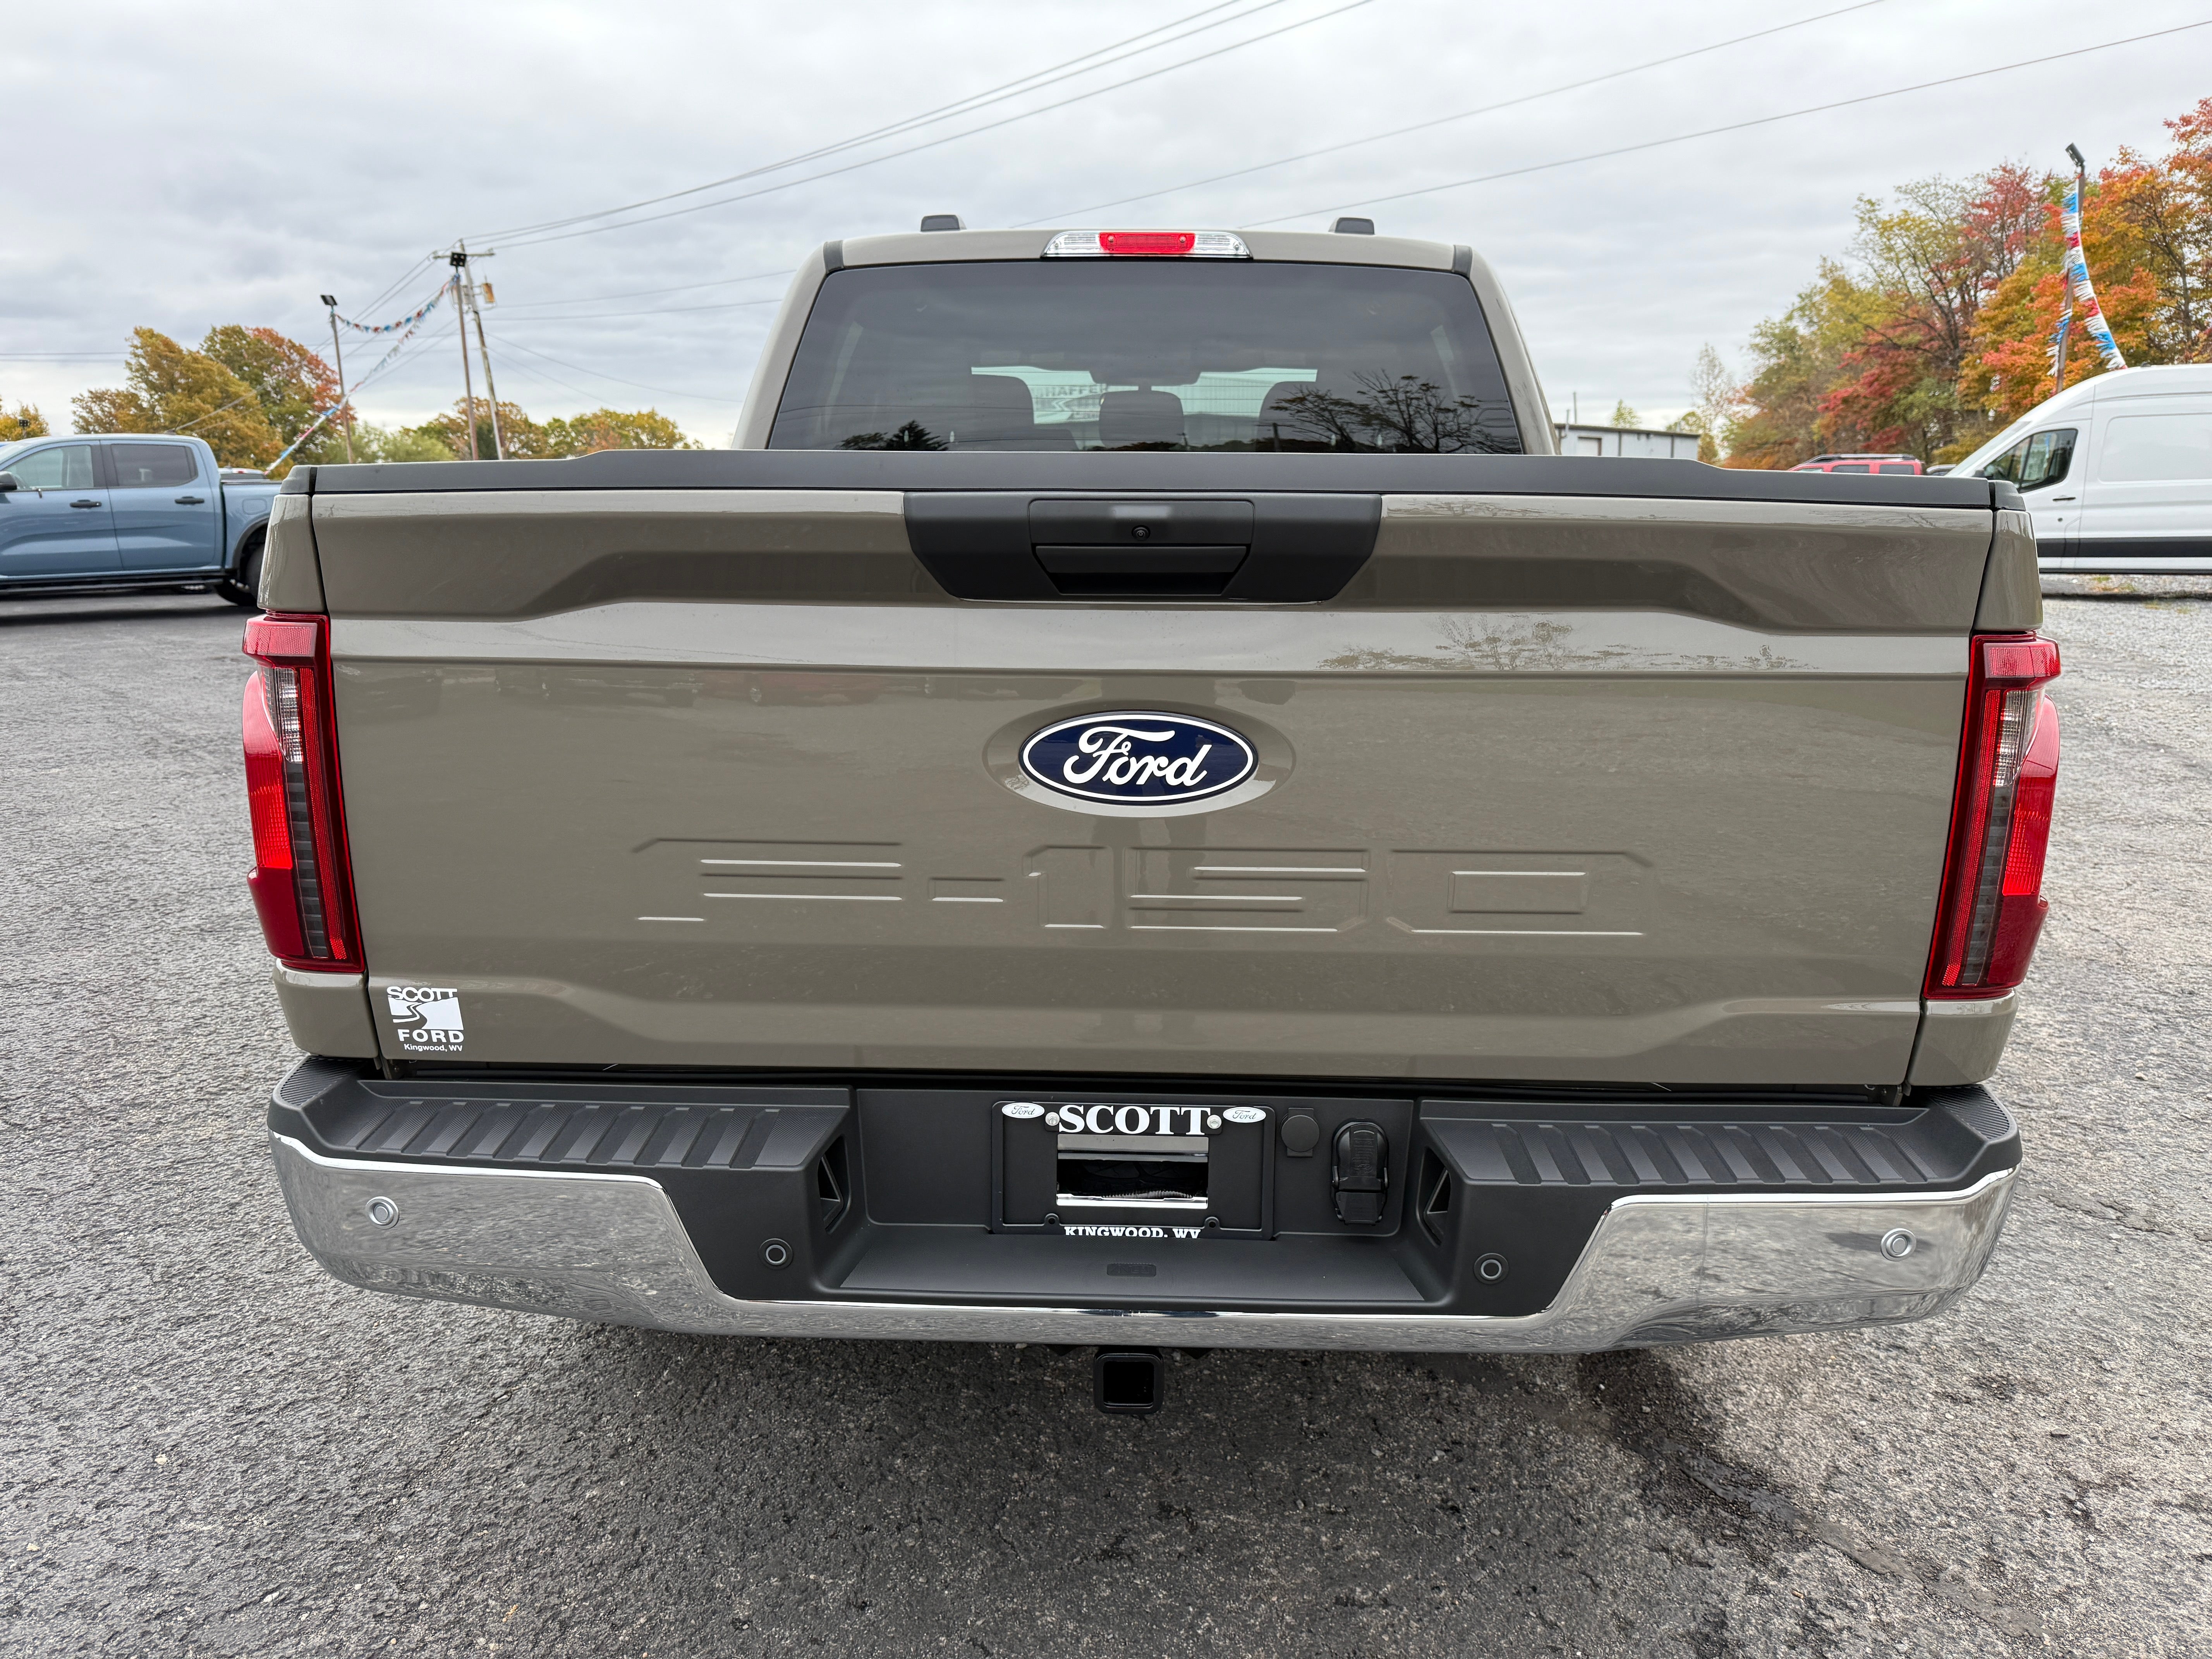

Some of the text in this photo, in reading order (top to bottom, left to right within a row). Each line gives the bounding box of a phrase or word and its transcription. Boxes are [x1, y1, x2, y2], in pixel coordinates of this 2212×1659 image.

[1063, 726, 1212, 787] Ford
[632, 836, 1657, 936] F-150
[387, 986, 457, 1002] SCOTT
[398, 1029, 464, 1042] FORD
[404, 1044, 447, 1052] Kingwood,
[1011, 1105, 1035, 1115] Ford
[1232, 1109, 1257, 1120] Ford
[1059, 1104, 1211, 1135] SCOTT
[1172, 1228, 1201, 1238] WV
